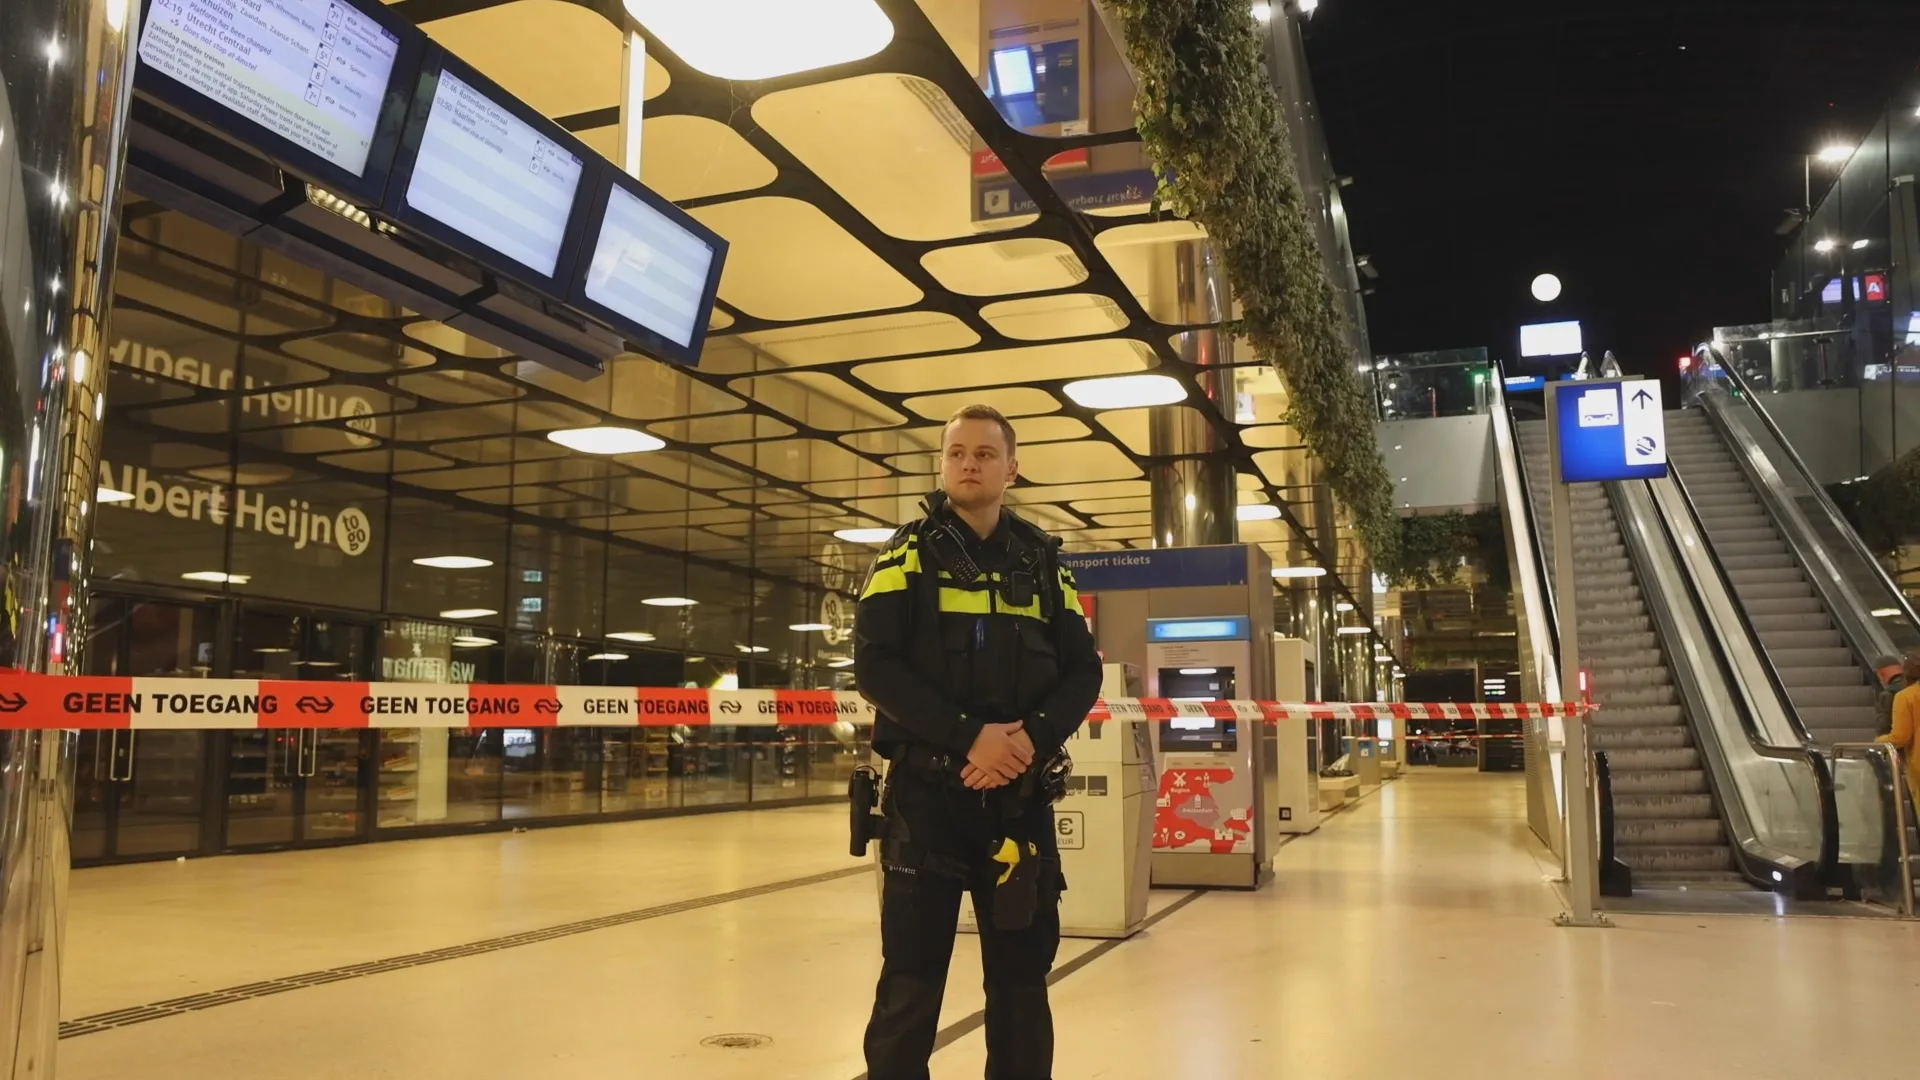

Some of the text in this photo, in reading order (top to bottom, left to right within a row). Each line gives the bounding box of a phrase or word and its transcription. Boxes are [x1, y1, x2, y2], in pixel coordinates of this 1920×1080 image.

[186, 11, 216, 36] Utrecht
[217, 30, 251, 56] Centraal
[189, 1, 272, 57] Platform has been changed
[150, 21, 225, 68] Zaterdag minder treinen
[169, 16, 256, 71] +5 Does not stop at Amstel
[147, 30, 175, 51] Zaterdag
[176, 47, 193, 61] rijden
[193, 57, 201, 66] op
[202, 62, 213, 71] een
[214, 67, 232, 81] aantal
[256, 91, 274, 105] minder
[142, 49, 162, 64] routes
[163, 60, 175, 71] due
[175, 67, 182, 75] to
[188, 74, 213, 93] shortage
[214, 88, 221, 96] of
[221, 92, 245, 109] available
[278, 122, 289, 133] plan
[290, 130, 301, 140] your
[177, 57, 190, 69] Plan
[201, 70, 211, 80] reis
[218, 80, 225, 88] de
[239, 92, 262, 109] Saturday
[263, 104, 278, 117] fewer
[279, 113, 292, 125] trains
[453, 107, 476, 127] Haarlem
[459, 88, 486, 112] Rotterdam
[486, 106, 507, 126] Centraal
[99, 459, 331, 550] Albert Heijn
[342, 513, 359, 533] to
[347, 524, 367, 551] go
[1064, 555, 1151, 569] ansport tickets
[63, 692, 278, 715] GEEN TOEGANG
[360, 696, 520, 715] GEEN TOEGANG
[584, 699, 709, 715] GEEN TOEGANG
[758, 700, 857, 715] GEEN TOEGANG
[1170, 786, 1191, 795] Region
[1058, 817, 1073, 835] €
